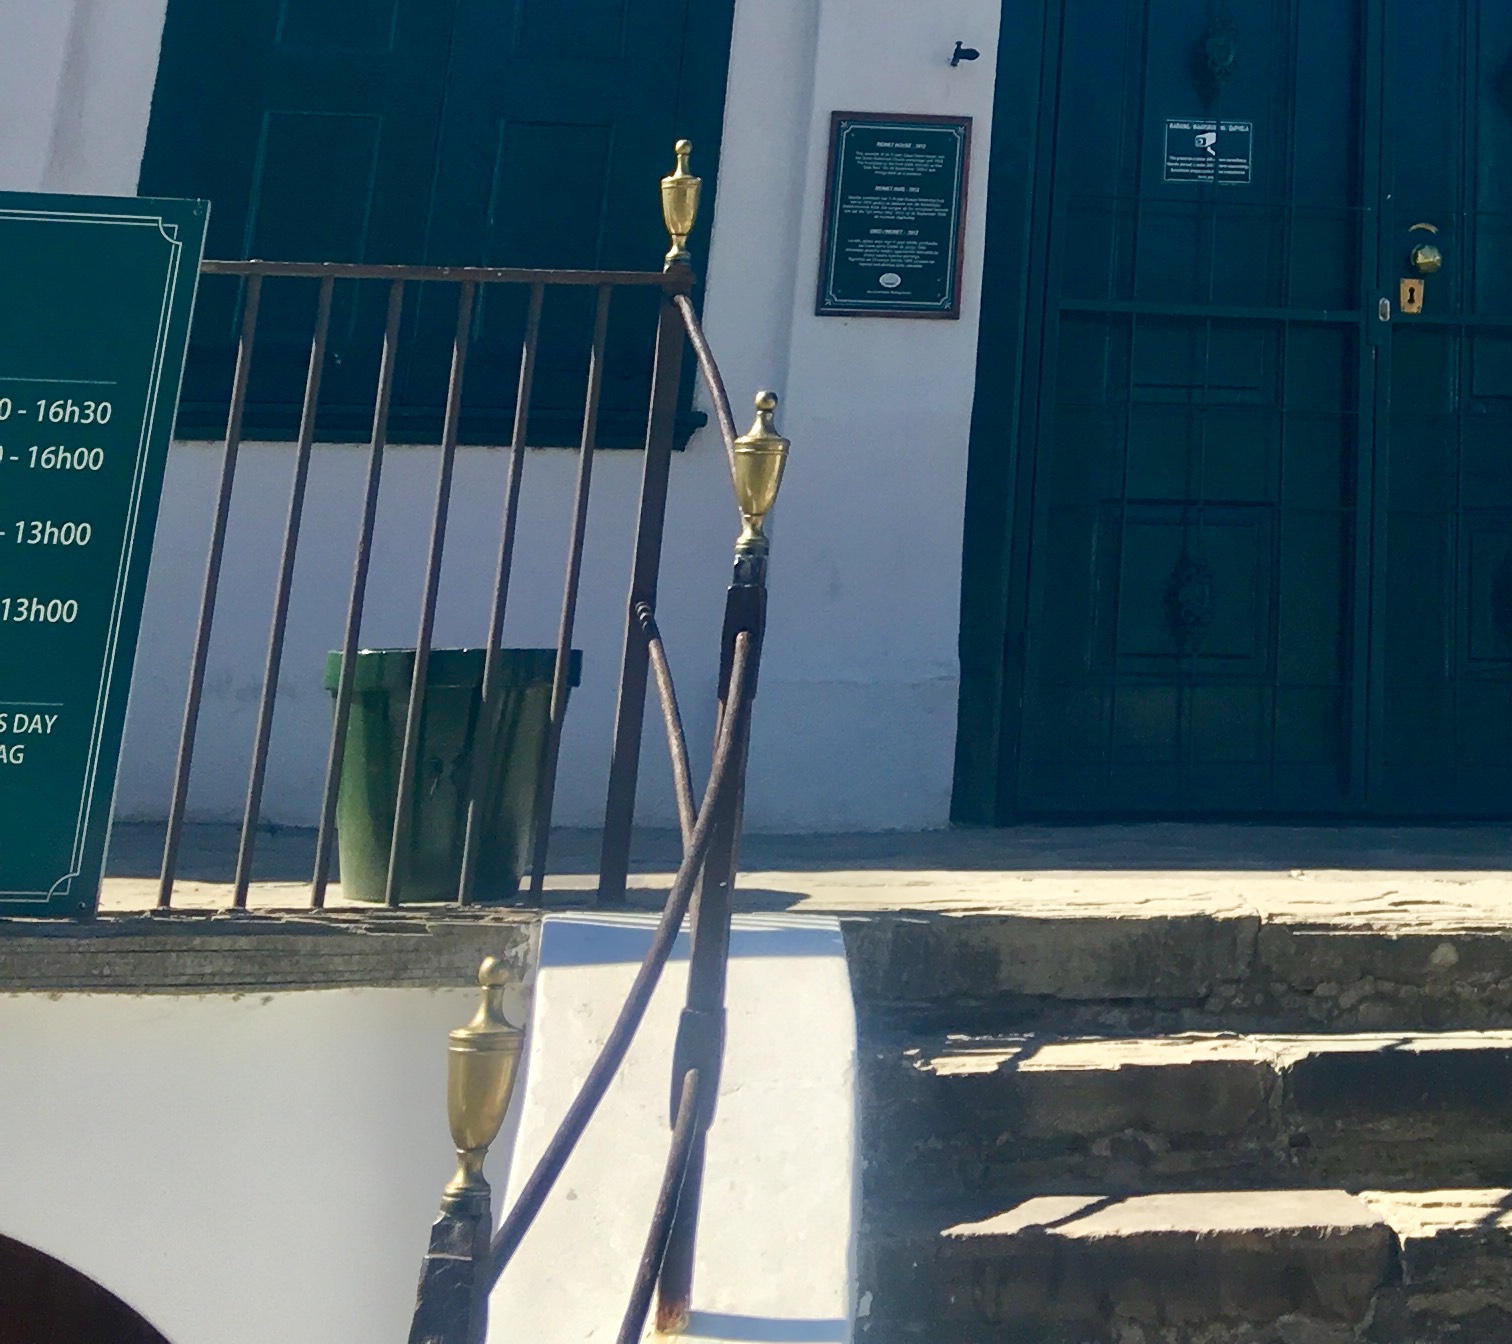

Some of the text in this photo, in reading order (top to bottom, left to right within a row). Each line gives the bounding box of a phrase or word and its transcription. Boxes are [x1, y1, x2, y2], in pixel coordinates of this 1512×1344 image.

[36, 399, 112, 424] 16h30
[28, 445, 104, 470] 16h00
[15, 520, 92, 545] 13h00
[1, 597, 78, 623] 13h00
[13, 713, 58, 734] DAY
